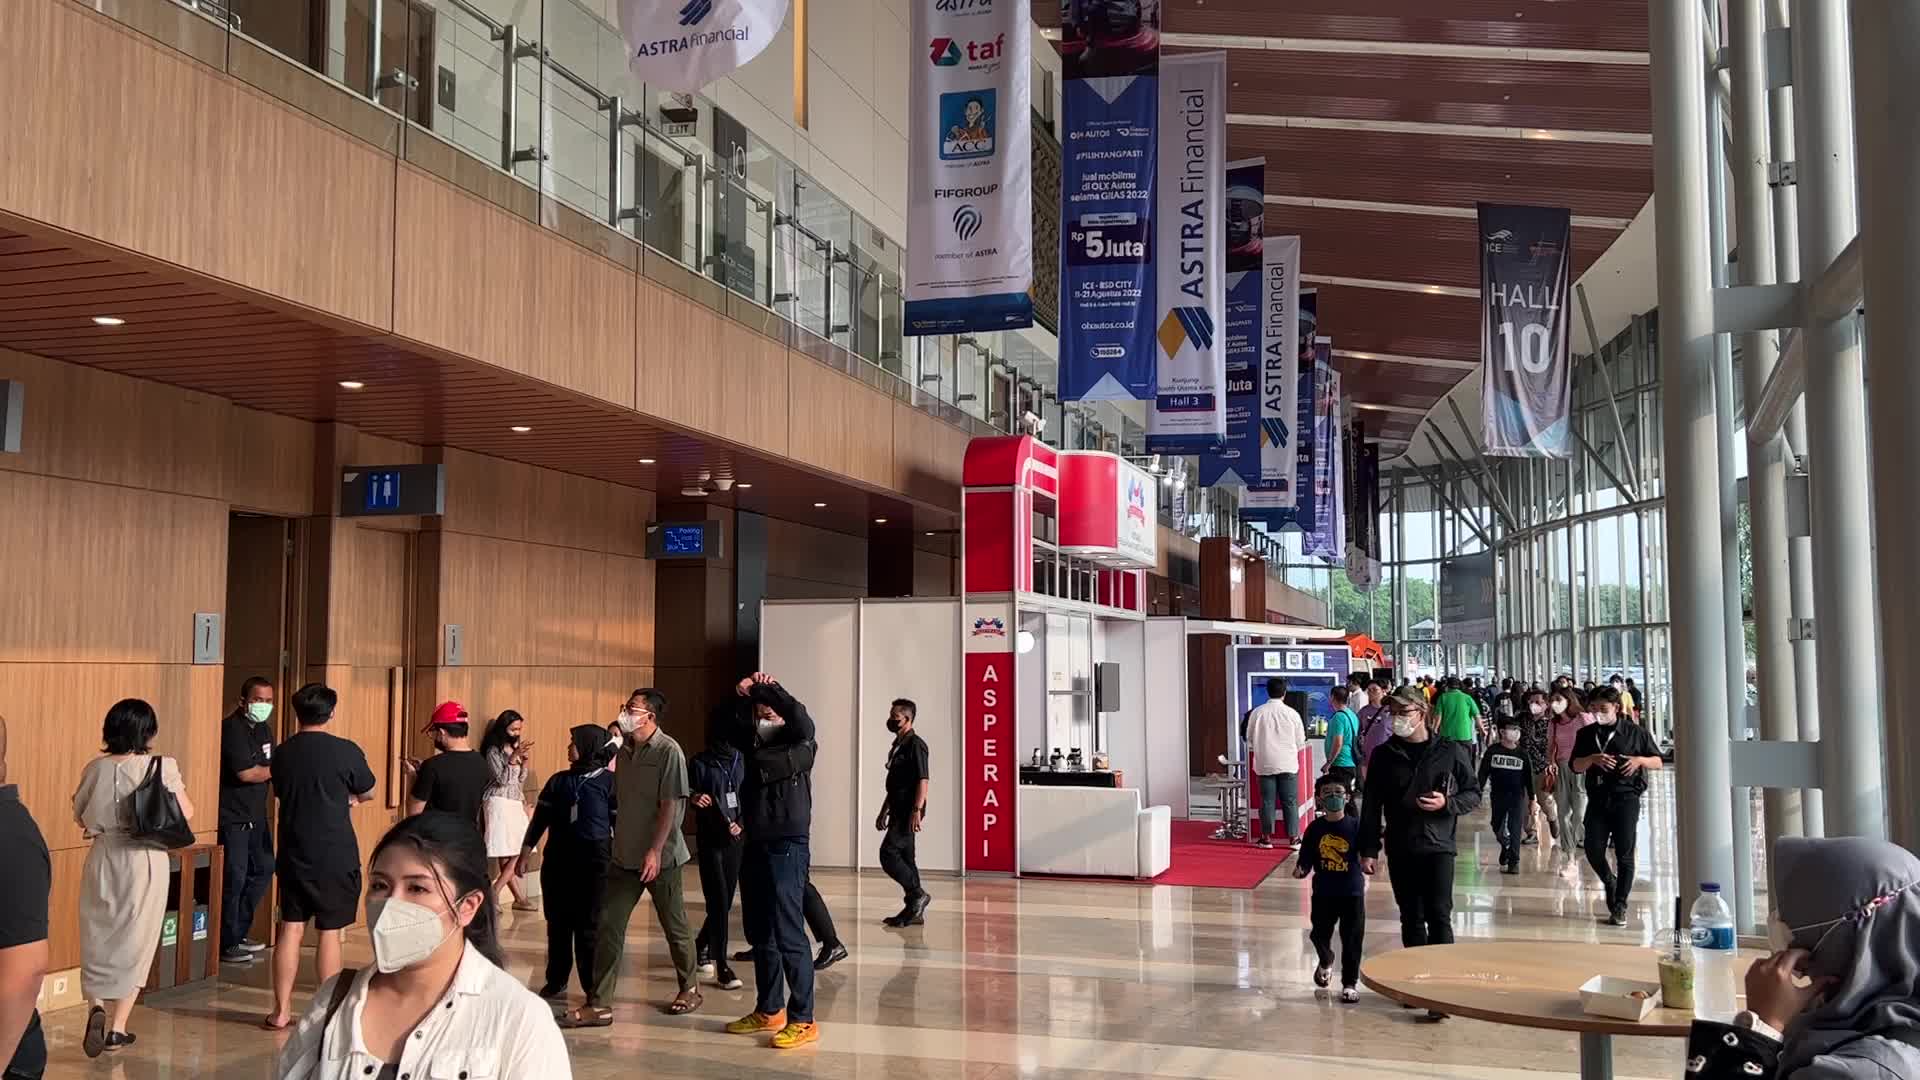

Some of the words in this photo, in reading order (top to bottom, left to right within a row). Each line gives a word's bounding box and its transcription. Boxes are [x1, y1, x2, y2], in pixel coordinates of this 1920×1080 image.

[637, 36, 689, 57] ASTRA
[967, 33, 1005, 61] taf
[1086, 129, 1111, 139] AUTOS
[1179, 88, 1205, 193] Financial
[951, 141, 986, 153] ACC
[731, 140, 746, 179] 10
[1098, 171, 1137, 181] mobilmu
[934, 184, 998, 199] FIFGROUP
[1081, 182, 1091, 191] di
[1091, 182, 1110, 191] OLX
[1111, 181, 1137, 190] Autos
[1070, 191, 1100, 202] selama
[1126, 189, 1148, 199] 2022
[1071, 231, 1085, 243] Rp
[1085, 230, 1105, 258] 5
[1180, 199, 1205, 299] ASTRA
[1486, 242, 1503, 254] ICE
[934, 252, 964, 261] member
[975, 247, 999, 258] ASTRA
[1082, 281, 1095, 290] ICE
[1115, 279, 1133, 289] CITY
[1091, 289, 1122, 300] Agustus
[1122, 288, 1142, 297] 2022
[1265, 262, 1286, 338] Financial
[1490, 282, 1560, 310] HALL
[1498, 321, 1552, 374] 10
[1264, 341, 1283, 412] ASTRA
[1170, 395, 1190, 407] Hall
[1191, 396, 1200, 406] 3
[982, 664, 999, 858] ASPERAPI
